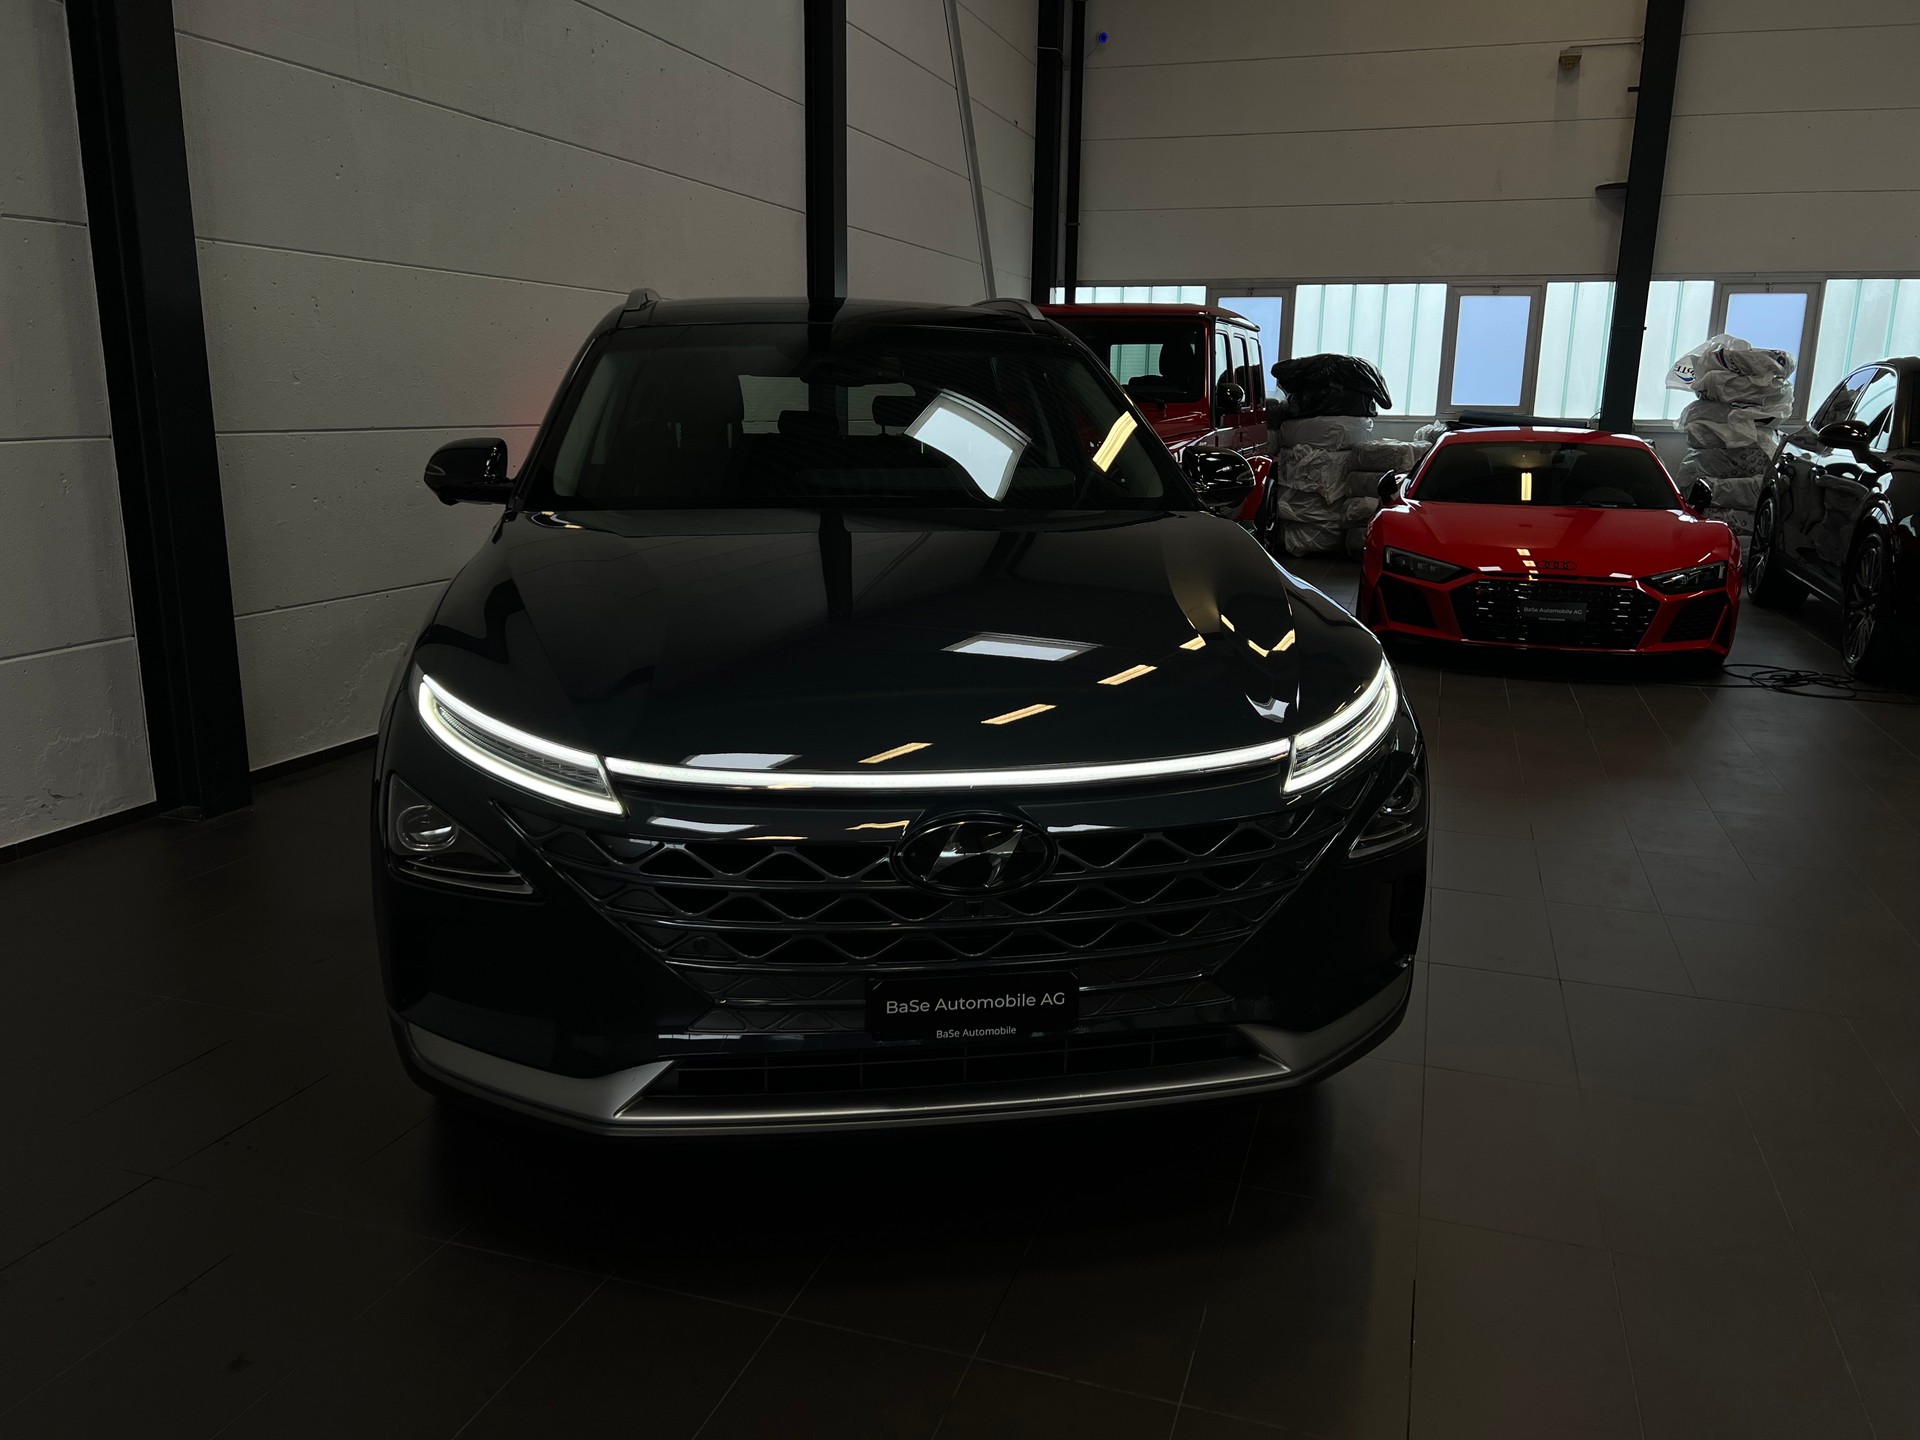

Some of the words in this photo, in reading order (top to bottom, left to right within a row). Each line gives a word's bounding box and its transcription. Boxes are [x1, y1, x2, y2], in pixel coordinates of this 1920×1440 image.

[886, 999, 930, 1014] BaSe
[935, 993, 1036, 1012] Automobile
[1040, 992, 1065, 1006] AG
[936, 1029, 960, 1039] BaSe
[962, 1025, 1017, 1037] Automobile
